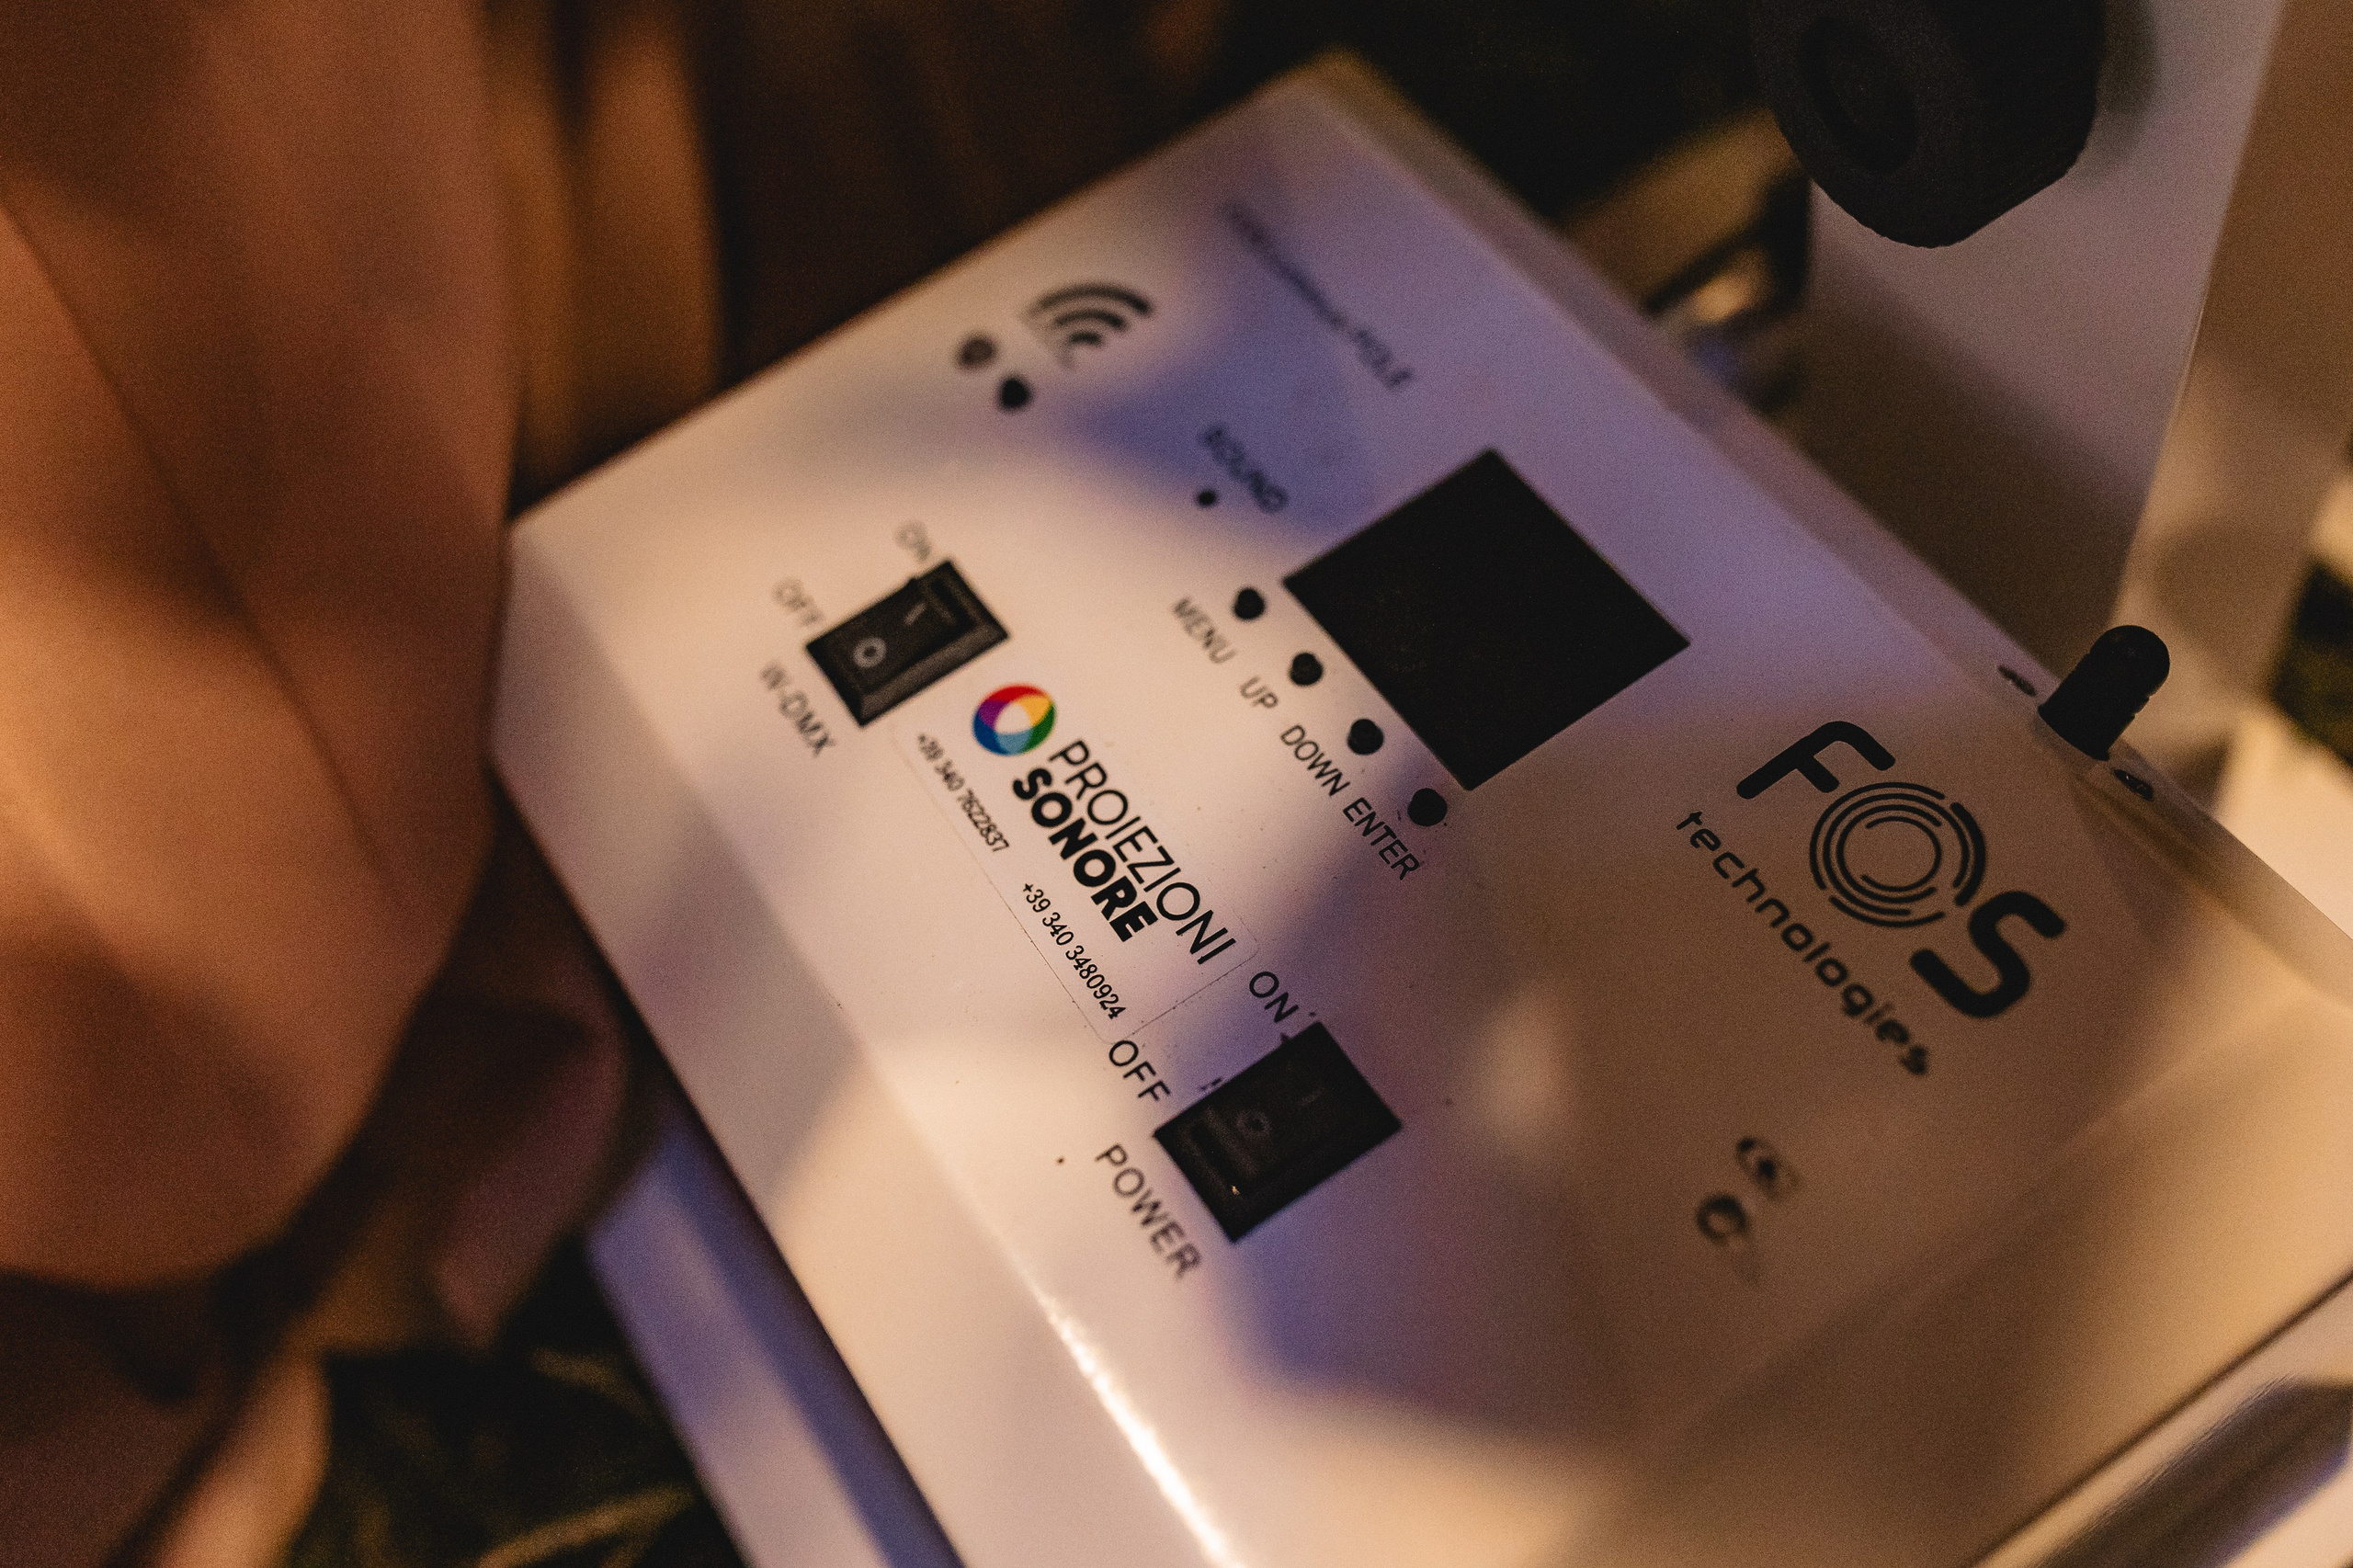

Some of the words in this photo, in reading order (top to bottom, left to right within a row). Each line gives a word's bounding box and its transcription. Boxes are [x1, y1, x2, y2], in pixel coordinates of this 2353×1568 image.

[1203, 425, 1288, 514] SOUND
[894, 520, 932, 562] ON
[772, 575, 824, 626] OFF
[1173, 597, 1238, 664] MENU
[760, 659, 835, 757] W-DMX
[1239, 676, 1279, 709] UP
[1279, 724, 1351, 797] DOWN
[1013, 767, 1159, 942] SONORE
[1048, 740, 1236, 965] PROIEZIONI
[1342, 797, 1421, 881] ENTER
[1736, 721, 2067, 1019] FOS
[1023, 883, 1051, 913] +39
[1042, 912, 1074, 946] 340
[1065, 945, 1126, 1019] 3480924
[1677, 811, 1929, 1076] technologies
[1248, 971, 1299, 1023] ON
[1108, 1040, 1171, 1102] OFF
[1095, 1142, 1202, 1280] POWER
